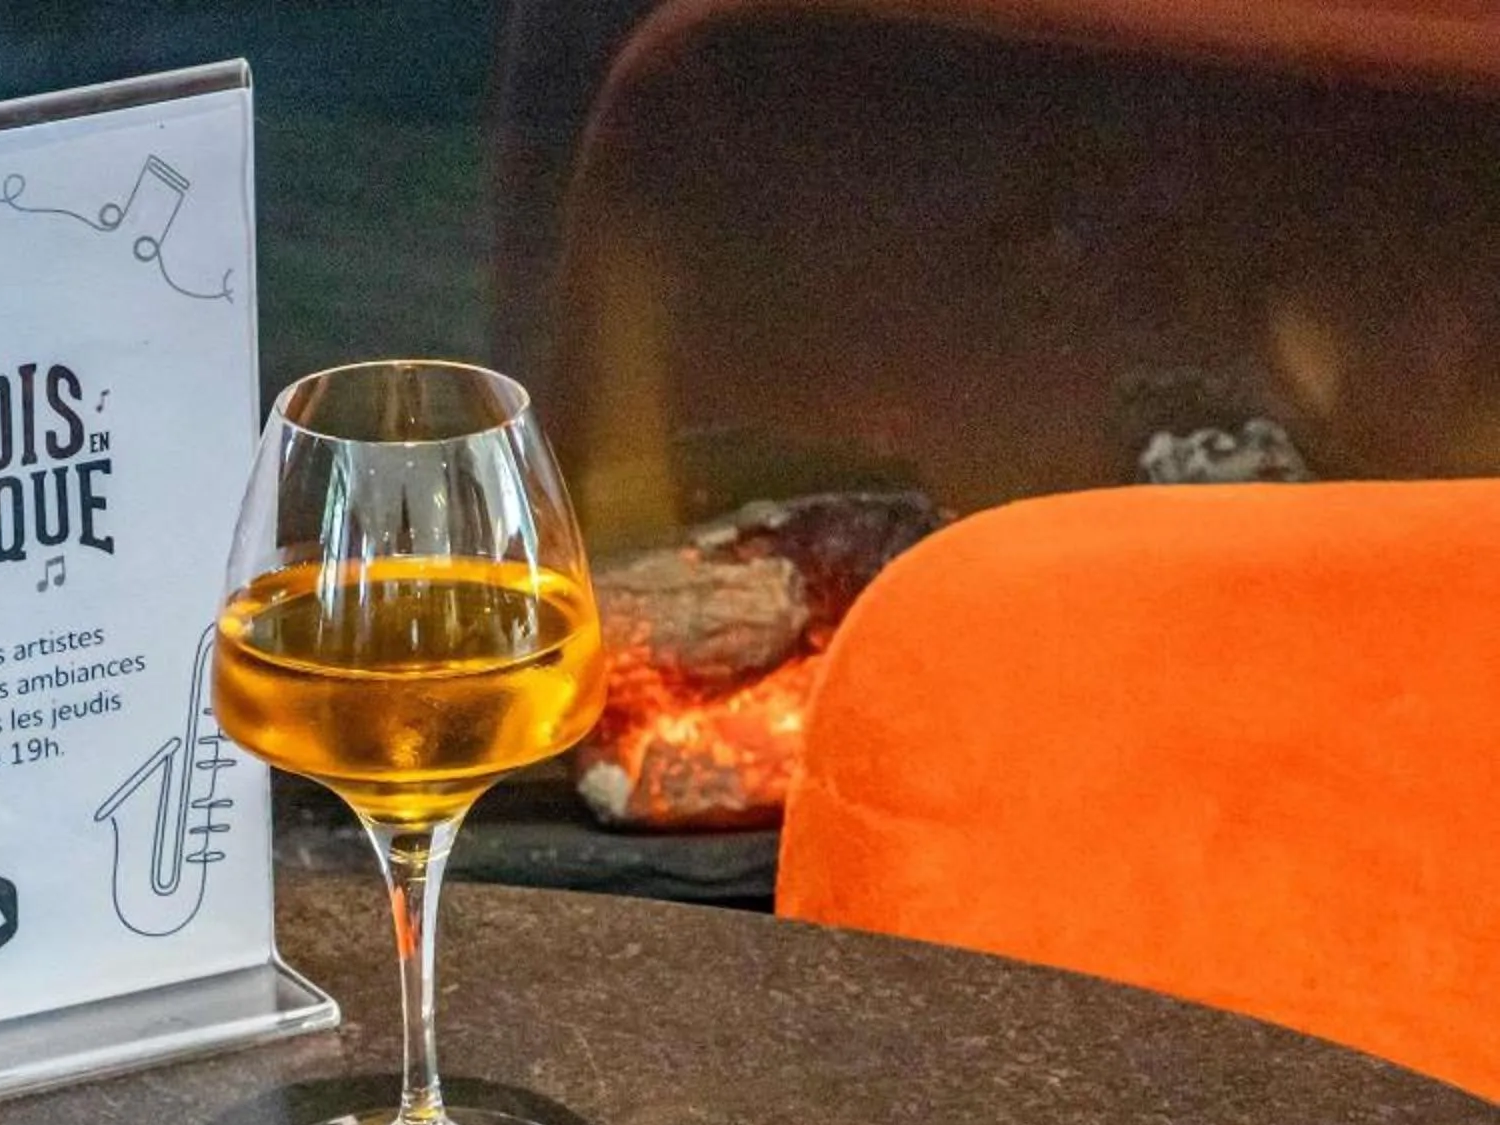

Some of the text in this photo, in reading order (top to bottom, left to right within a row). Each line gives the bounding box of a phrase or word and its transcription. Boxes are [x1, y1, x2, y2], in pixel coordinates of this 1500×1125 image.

[89, 432, 110, 454] EN
[14, 628, 105, 663] artistes
[17, 654, 146, 696] ambiances
[11, 707, 44, 731] les
[50, 691, 123, 730] jeudis
[11, 738, 66, 766] 19h.
